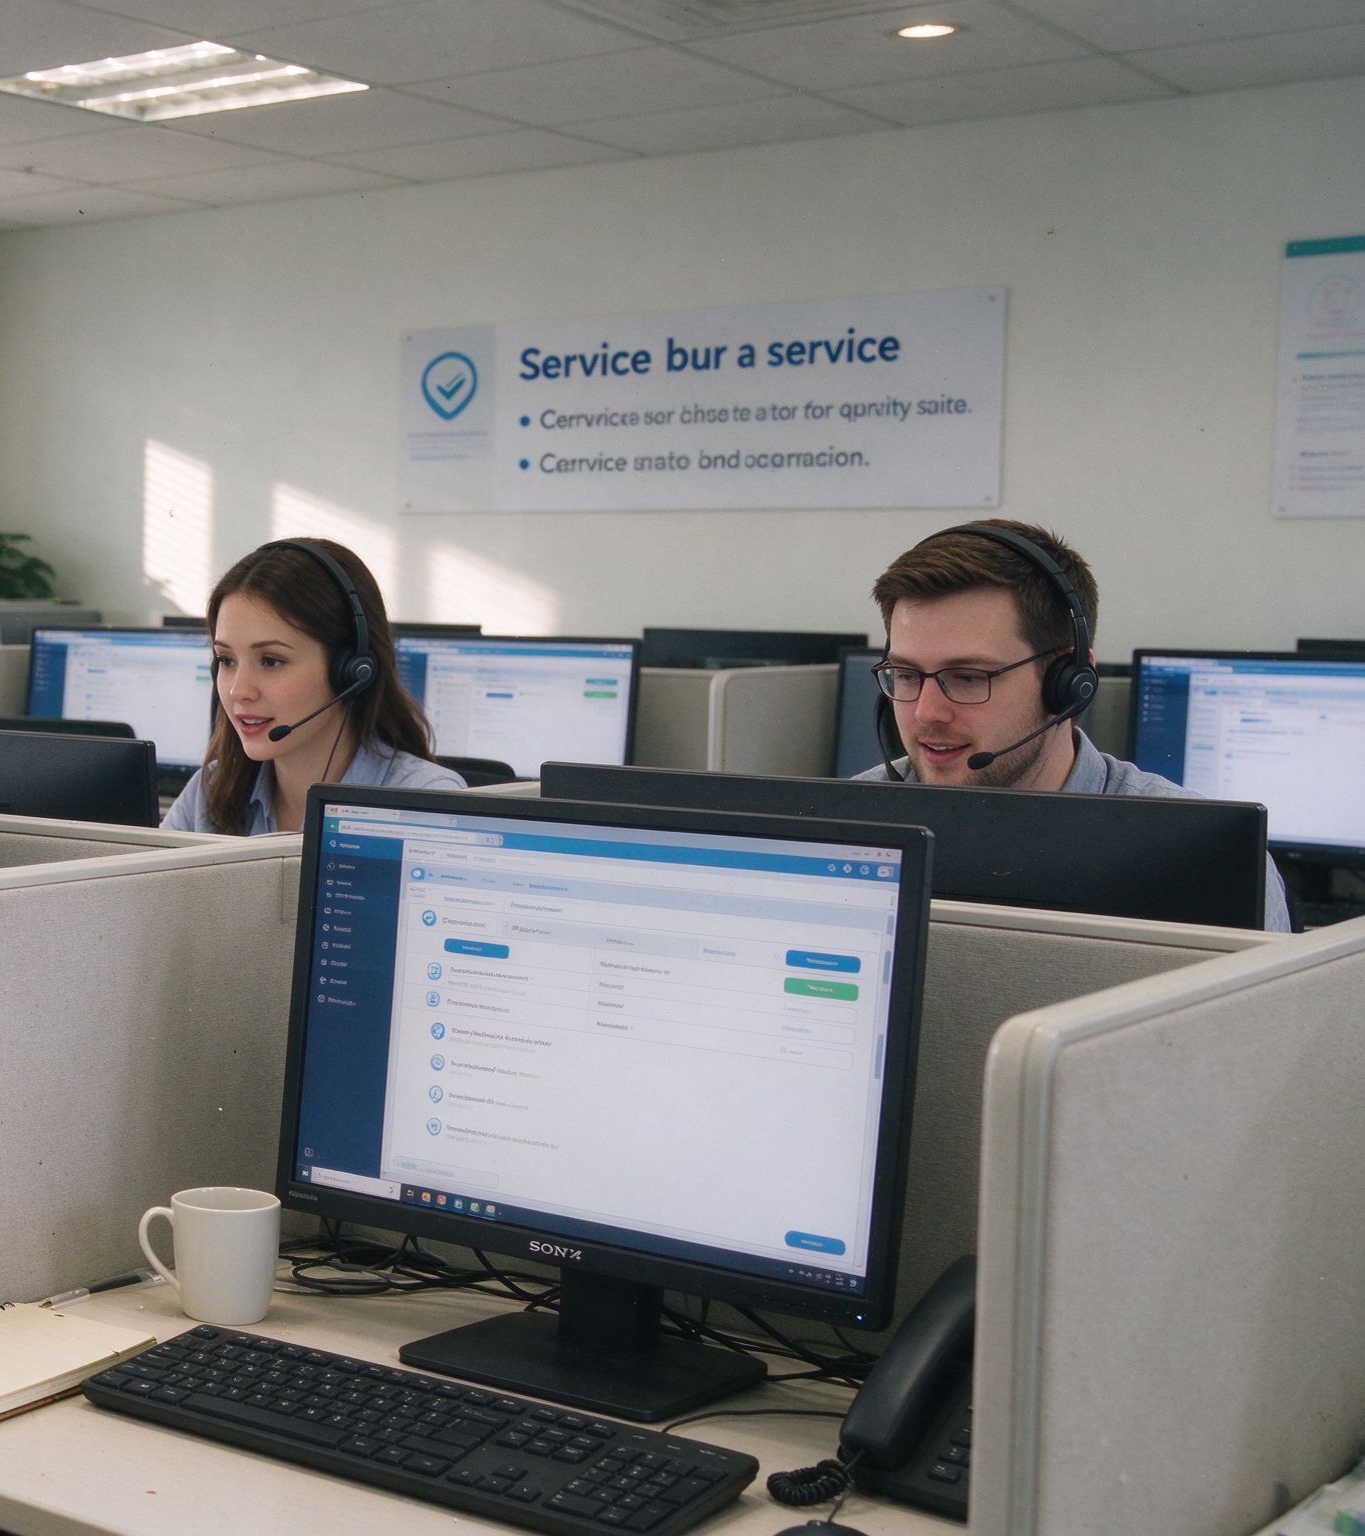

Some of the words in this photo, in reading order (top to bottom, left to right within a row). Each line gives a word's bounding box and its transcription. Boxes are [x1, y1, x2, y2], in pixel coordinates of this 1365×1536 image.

[519, 341, 652, 381] Service
[666, 336, 727, 372] bur
[737, 343, 756, 369] a
[767, 326, 901, 367] service
[804, 400, 834, 420] for
